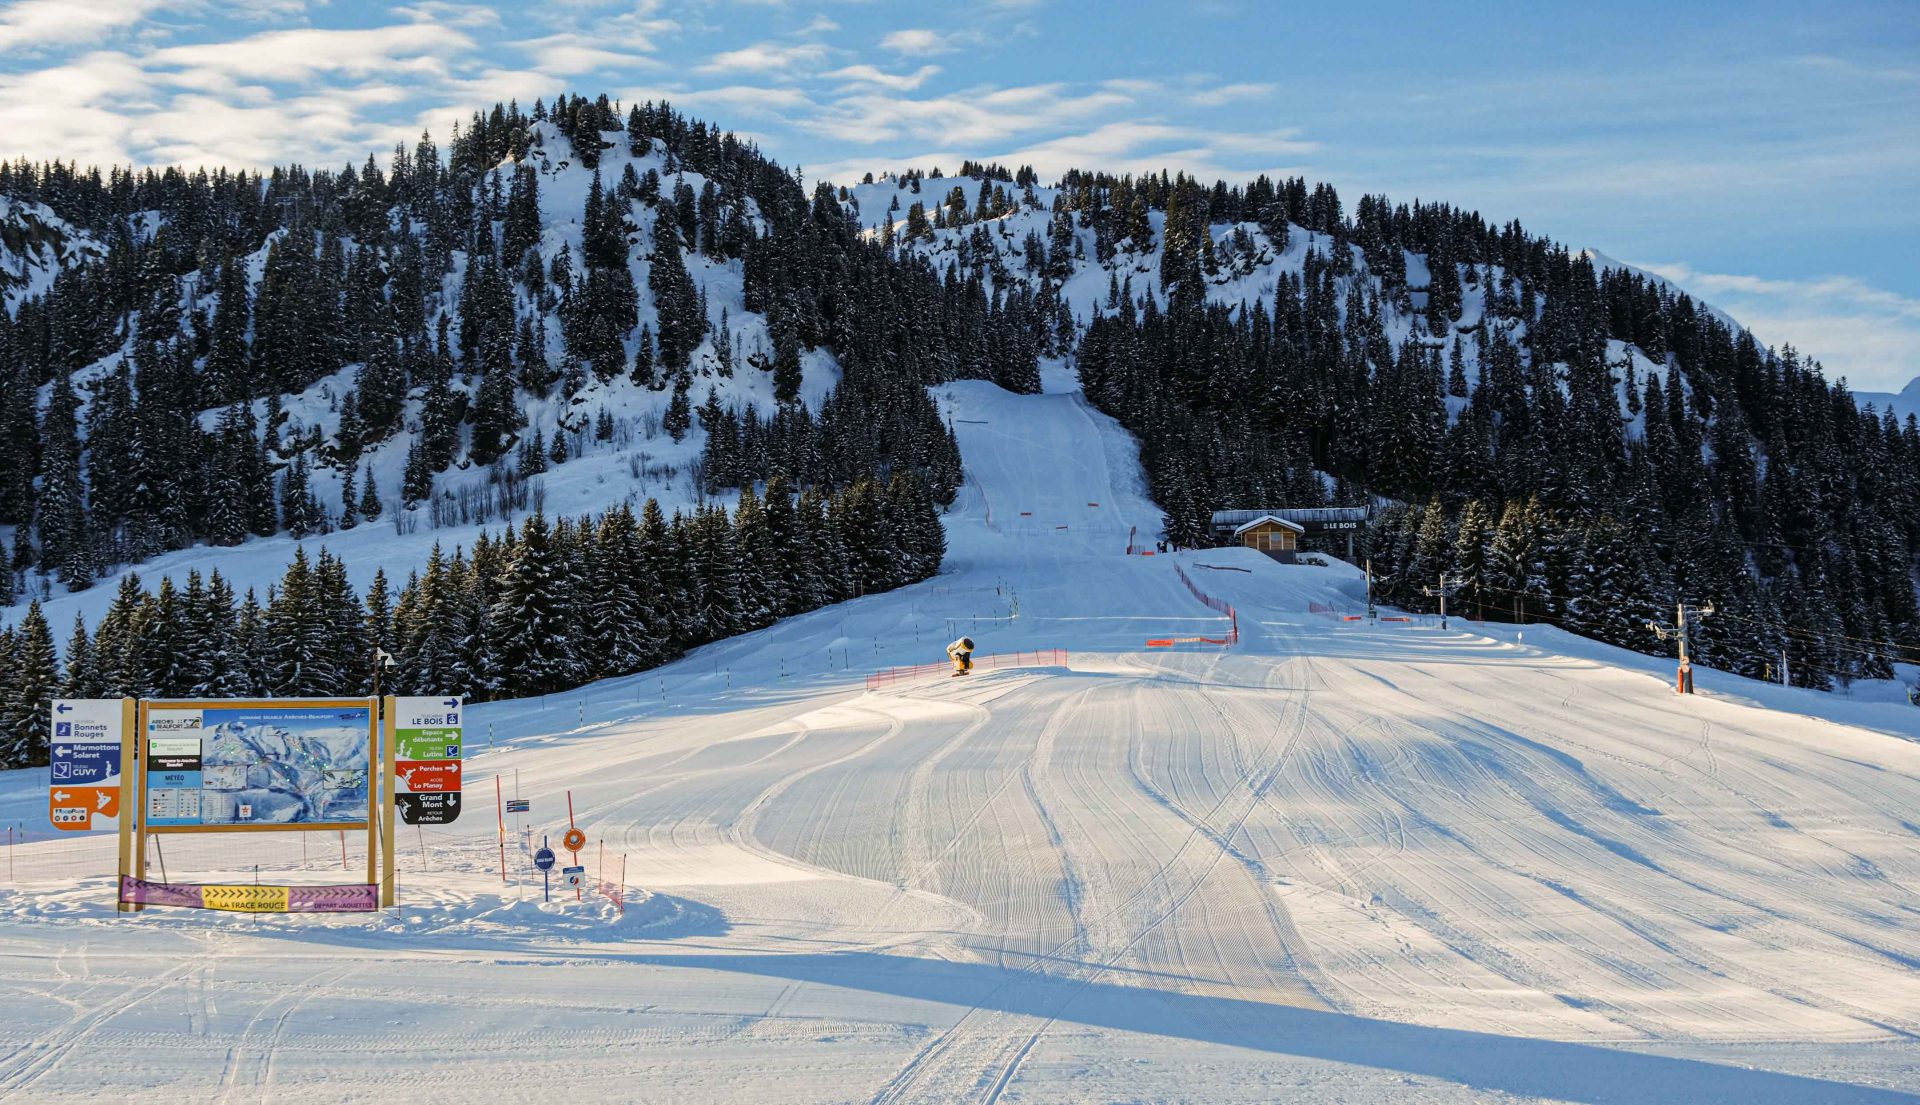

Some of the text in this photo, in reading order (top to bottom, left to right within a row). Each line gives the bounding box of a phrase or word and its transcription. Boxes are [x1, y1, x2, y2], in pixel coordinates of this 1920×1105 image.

[74, 731, 105, 739] Rouges
[72, 751, 101, 759] Solaret
[72, 768, 97, 776] CUVY
[419, 793, 443, 801] Grand
[257, 901, 285, 909] ROUGE
